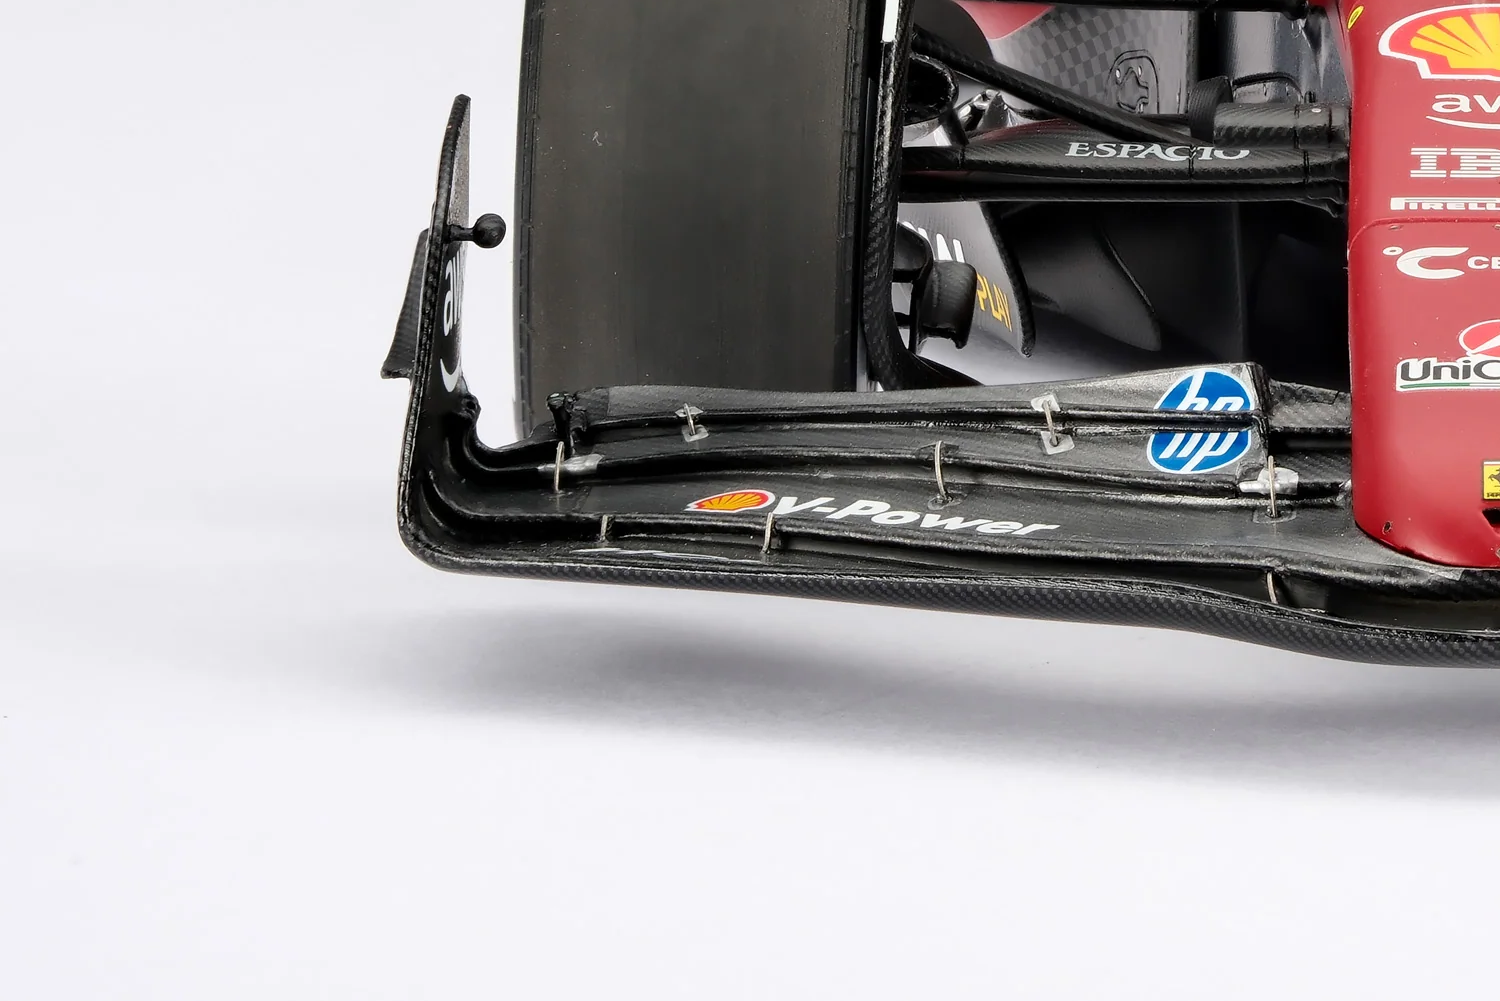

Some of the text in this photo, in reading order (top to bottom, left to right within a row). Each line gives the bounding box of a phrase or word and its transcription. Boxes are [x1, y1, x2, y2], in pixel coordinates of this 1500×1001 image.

[1065, 142, 1250, 161] ESPACIO
[1158, 370, 1246, 472] hp
[772, 497, 1061, 536] V-Power
